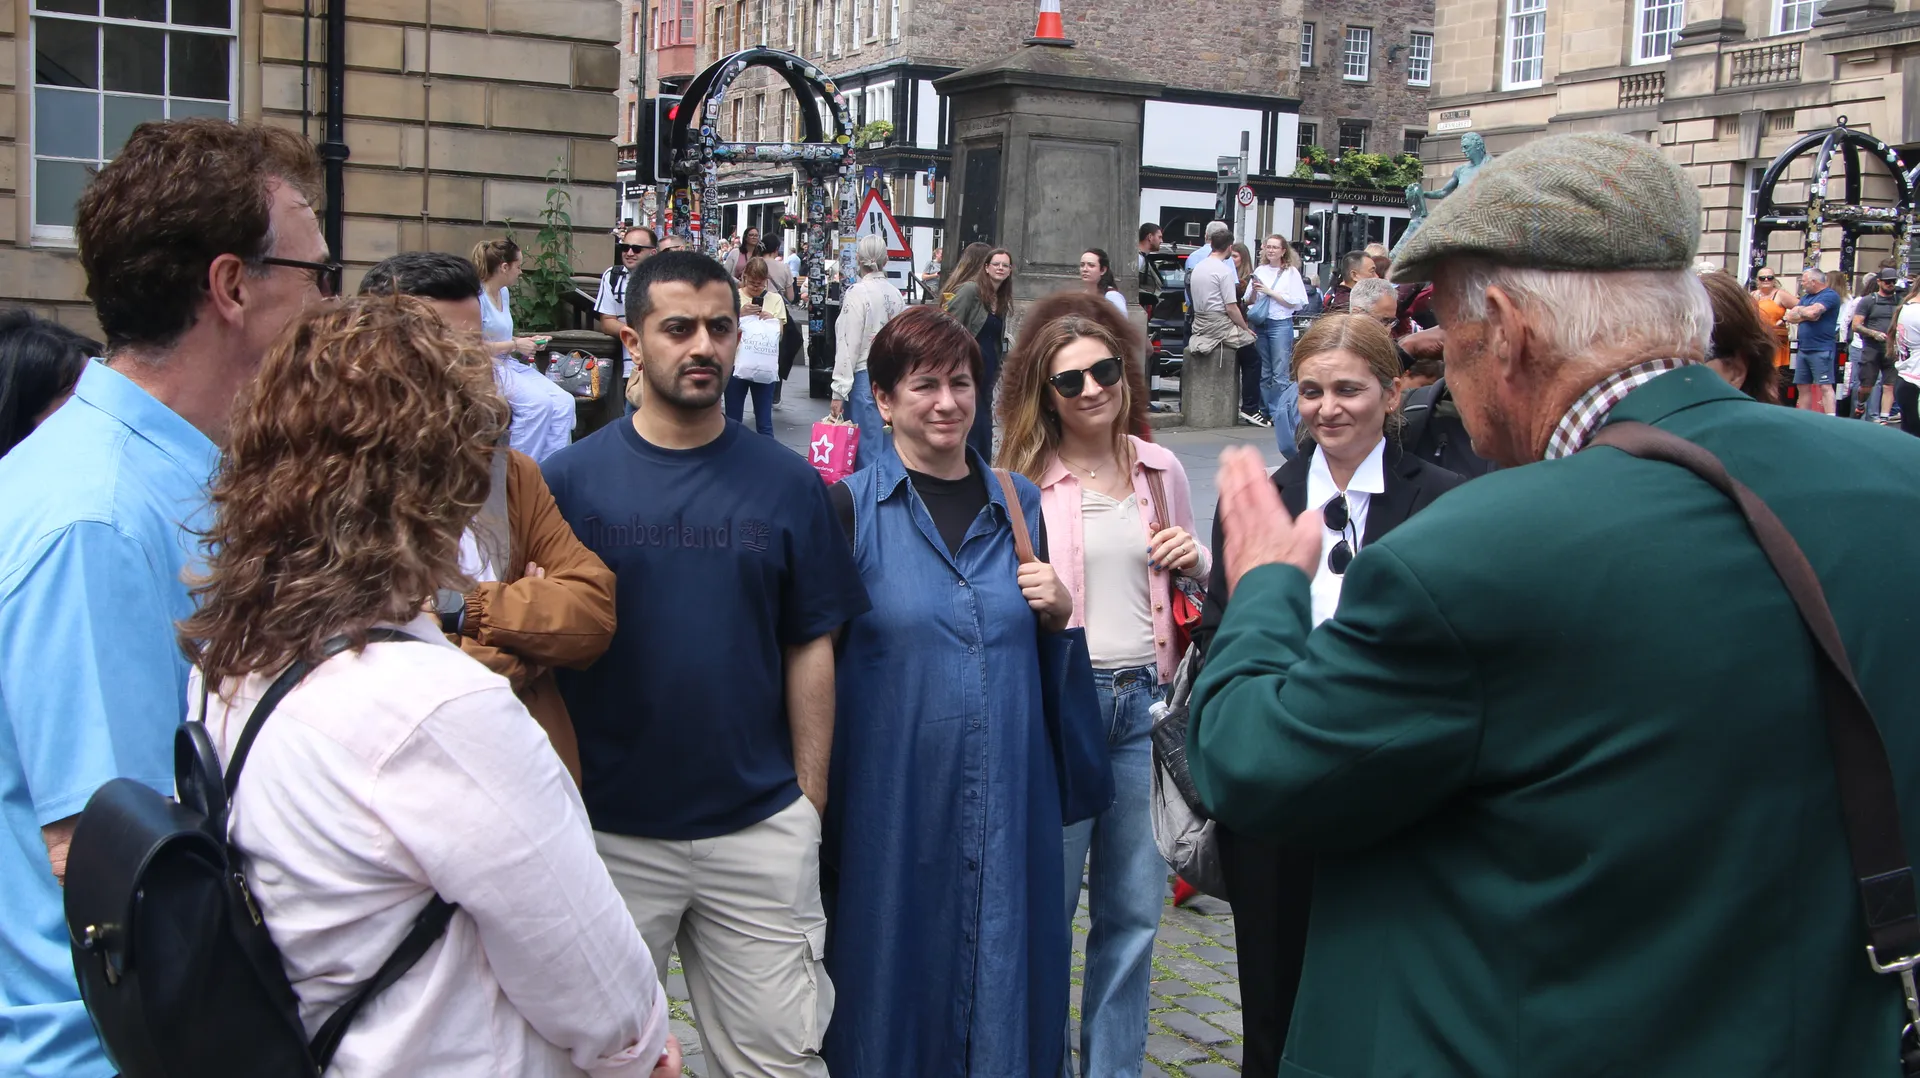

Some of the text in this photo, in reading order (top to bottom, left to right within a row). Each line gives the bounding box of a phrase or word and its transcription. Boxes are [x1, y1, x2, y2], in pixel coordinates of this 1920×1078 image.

[1240, 191, 1252, 201] 20
[1330, 191, 1409, 204] DEACON BRODIE
[584, 514, 732, 548] Timberland
